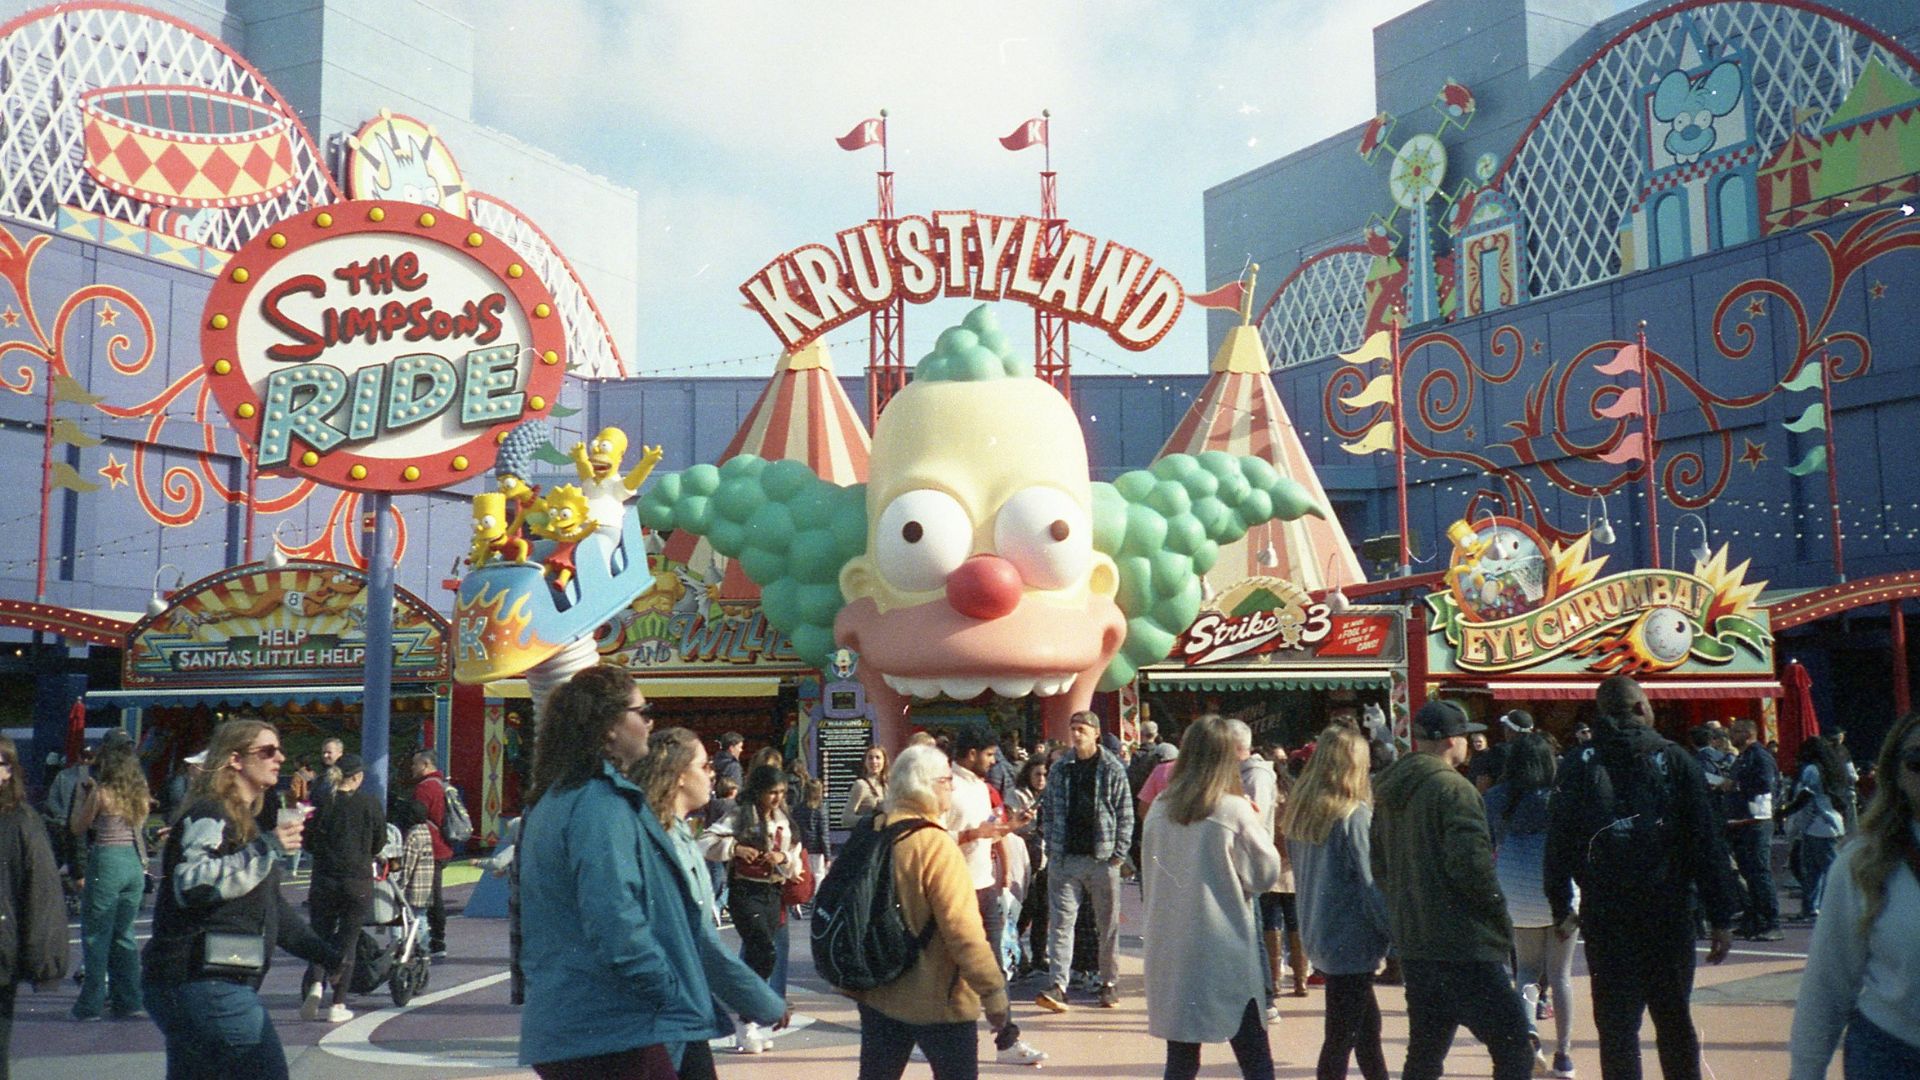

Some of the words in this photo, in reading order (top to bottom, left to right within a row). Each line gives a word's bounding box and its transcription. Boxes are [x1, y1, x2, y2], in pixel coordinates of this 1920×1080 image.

[864, 121, 880, 143] K
[1028, 121, 1043, 142] K
[742, 212, 1184, 348] KRUSTYLAND
[260, 274, 507, 362] SIMPSONS
[257, 343, 527, 470] RIDE
[288, 592, 299, 607] 8
[1184, 610, 1281, 654] Strike
[1301, 603, 1332, 642] 3
[1462, 620, 1535, 664] EYE
[1532, 575, 1709, 650] CARUMBA!
[258, 629, 307, 648] HELP
[459, 616, 489, 661] K
[630, 639, 672, 666] AND
[179, 651, 251, 668] SANTA'S
[256, 649, 316, 666] LITTLE
[319, 648, 365, 664] HELP
